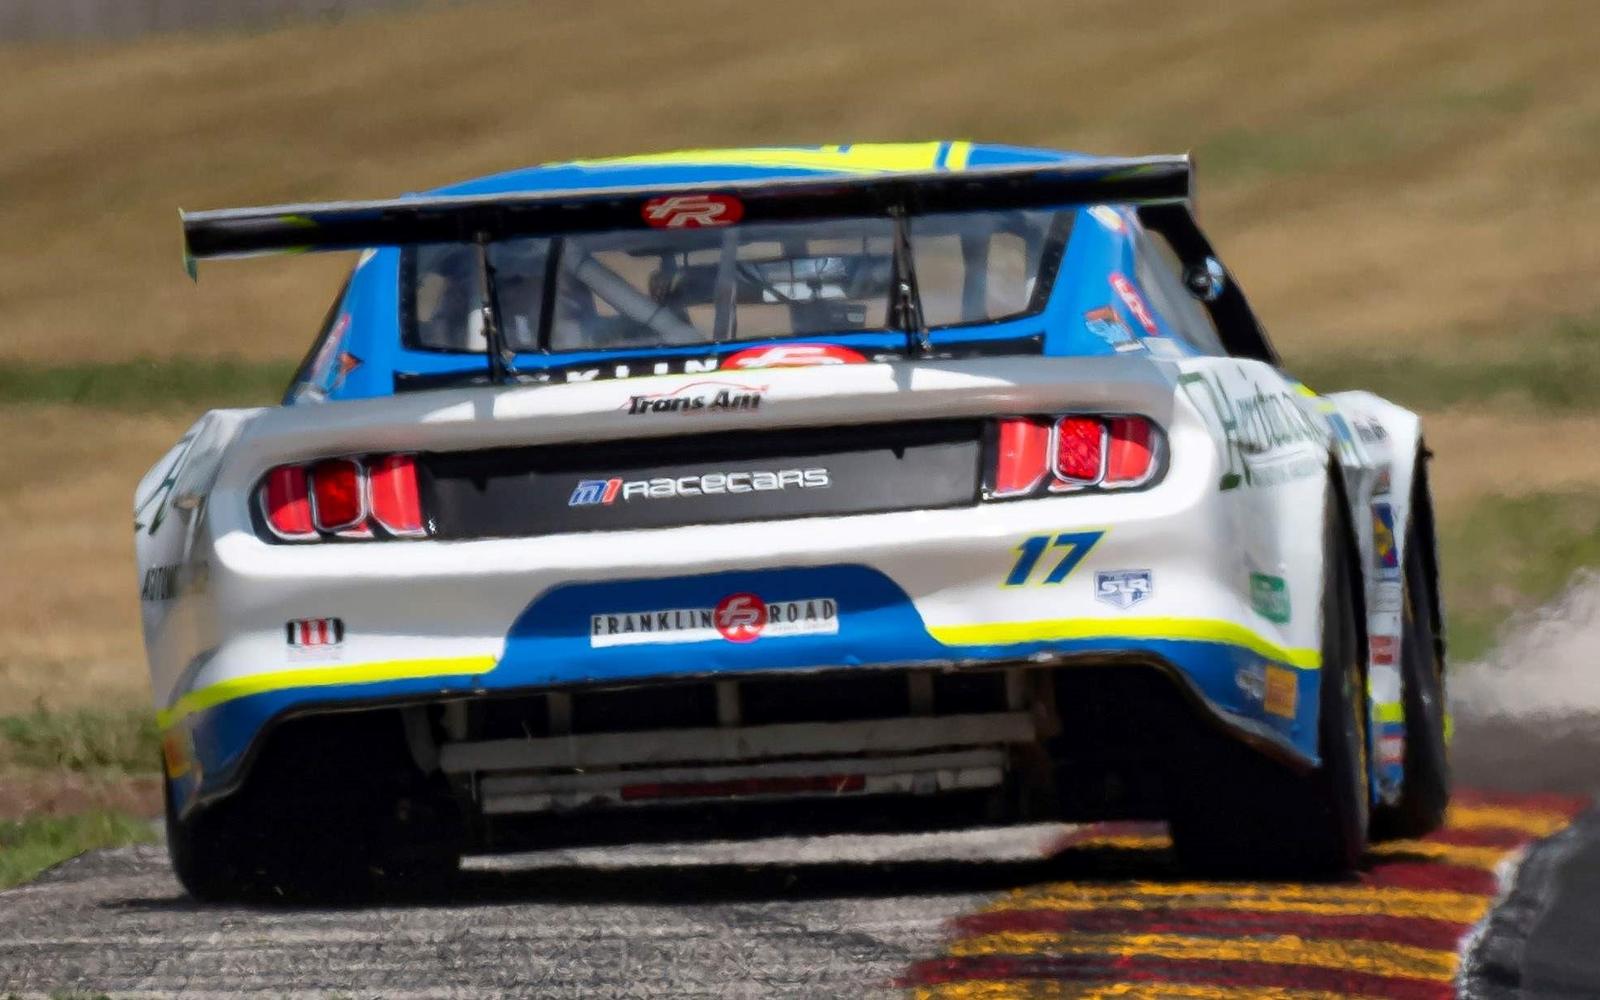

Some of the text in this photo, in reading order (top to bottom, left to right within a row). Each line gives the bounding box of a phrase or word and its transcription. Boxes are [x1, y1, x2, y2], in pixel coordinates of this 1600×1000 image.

[627, 388, 762, 415] Trans Am
[1002, 530, 1107, 588] 17
[593, 610, 713, 636] FRANKLIN
[768, 599, 834, 624] ROAD
